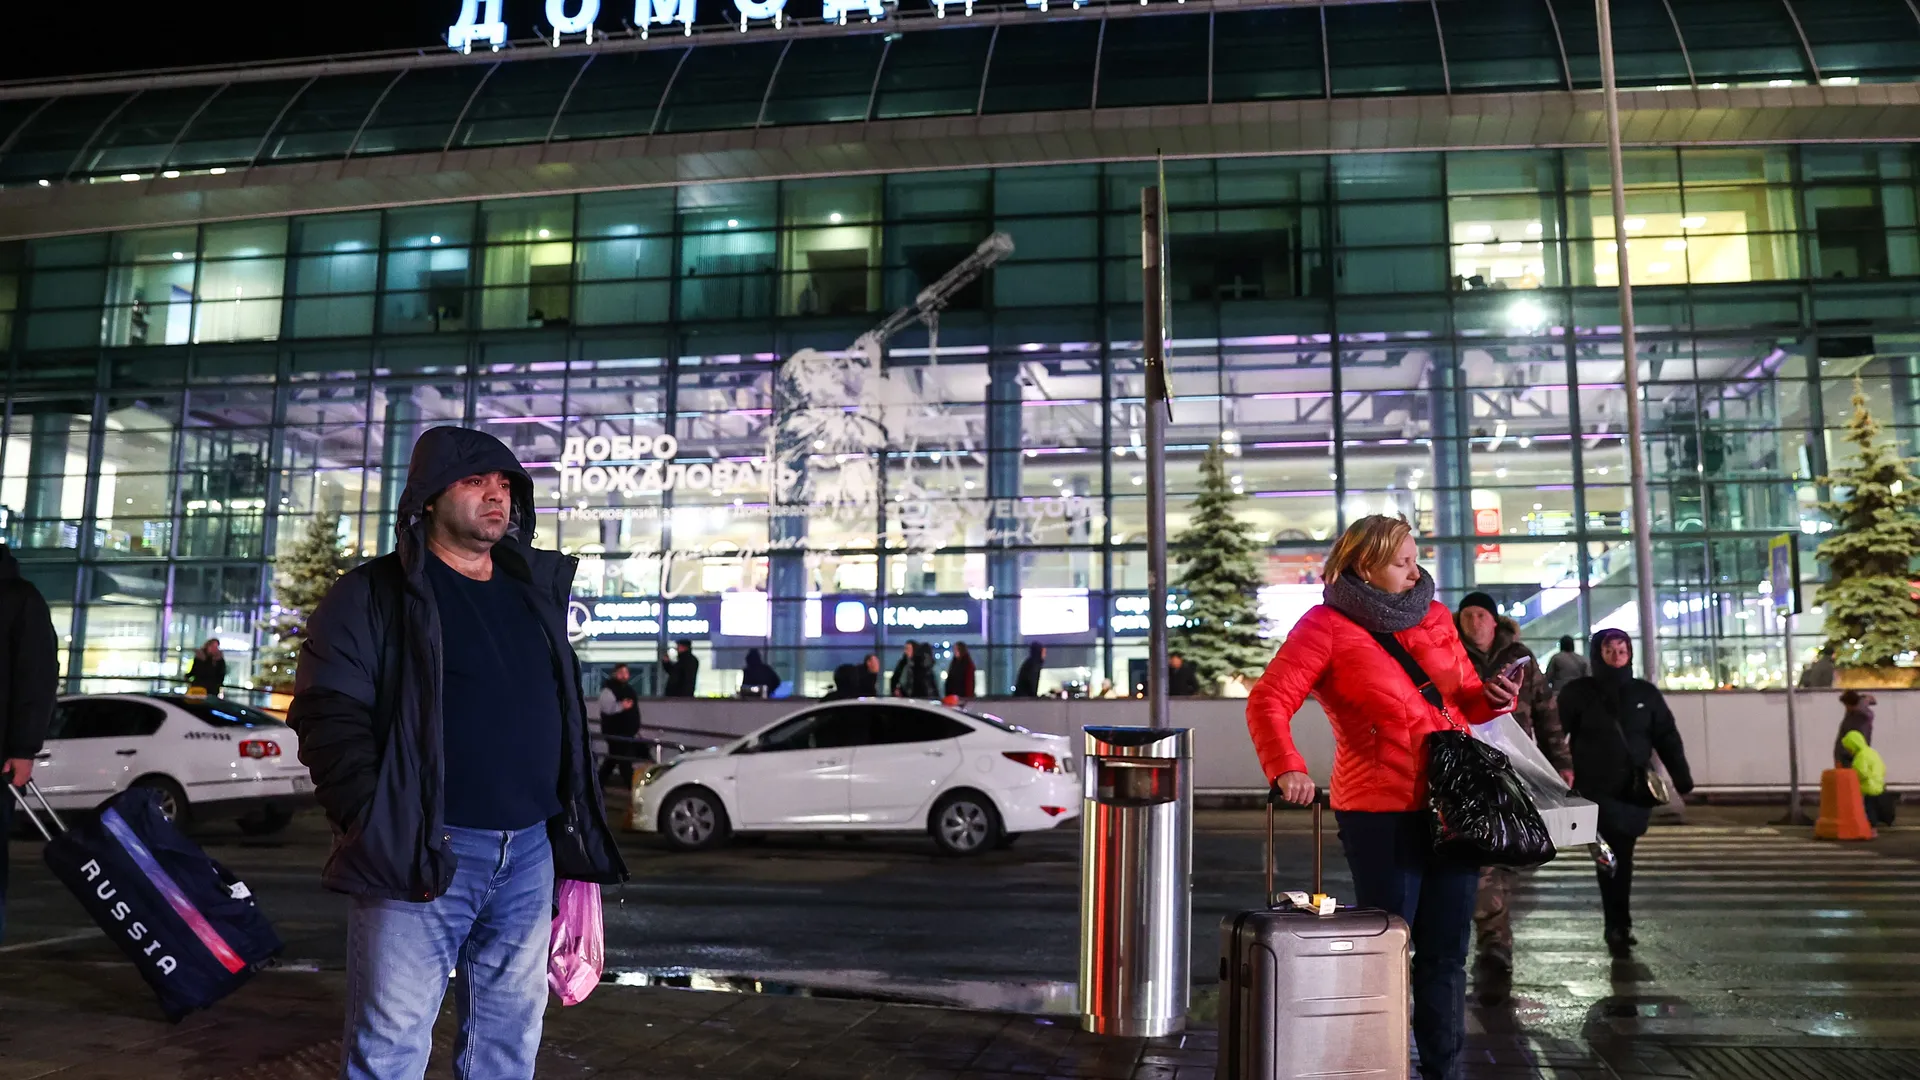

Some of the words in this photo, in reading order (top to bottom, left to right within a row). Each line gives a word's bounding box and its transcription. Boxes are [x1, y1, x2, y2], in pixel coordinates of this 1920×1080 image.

[563, 434, 678, 465] ДОБРО
[560, 461, 798, 493] ПОЖАЛОВАТЬ
[80, 858, 177, 976] RUSSIA
